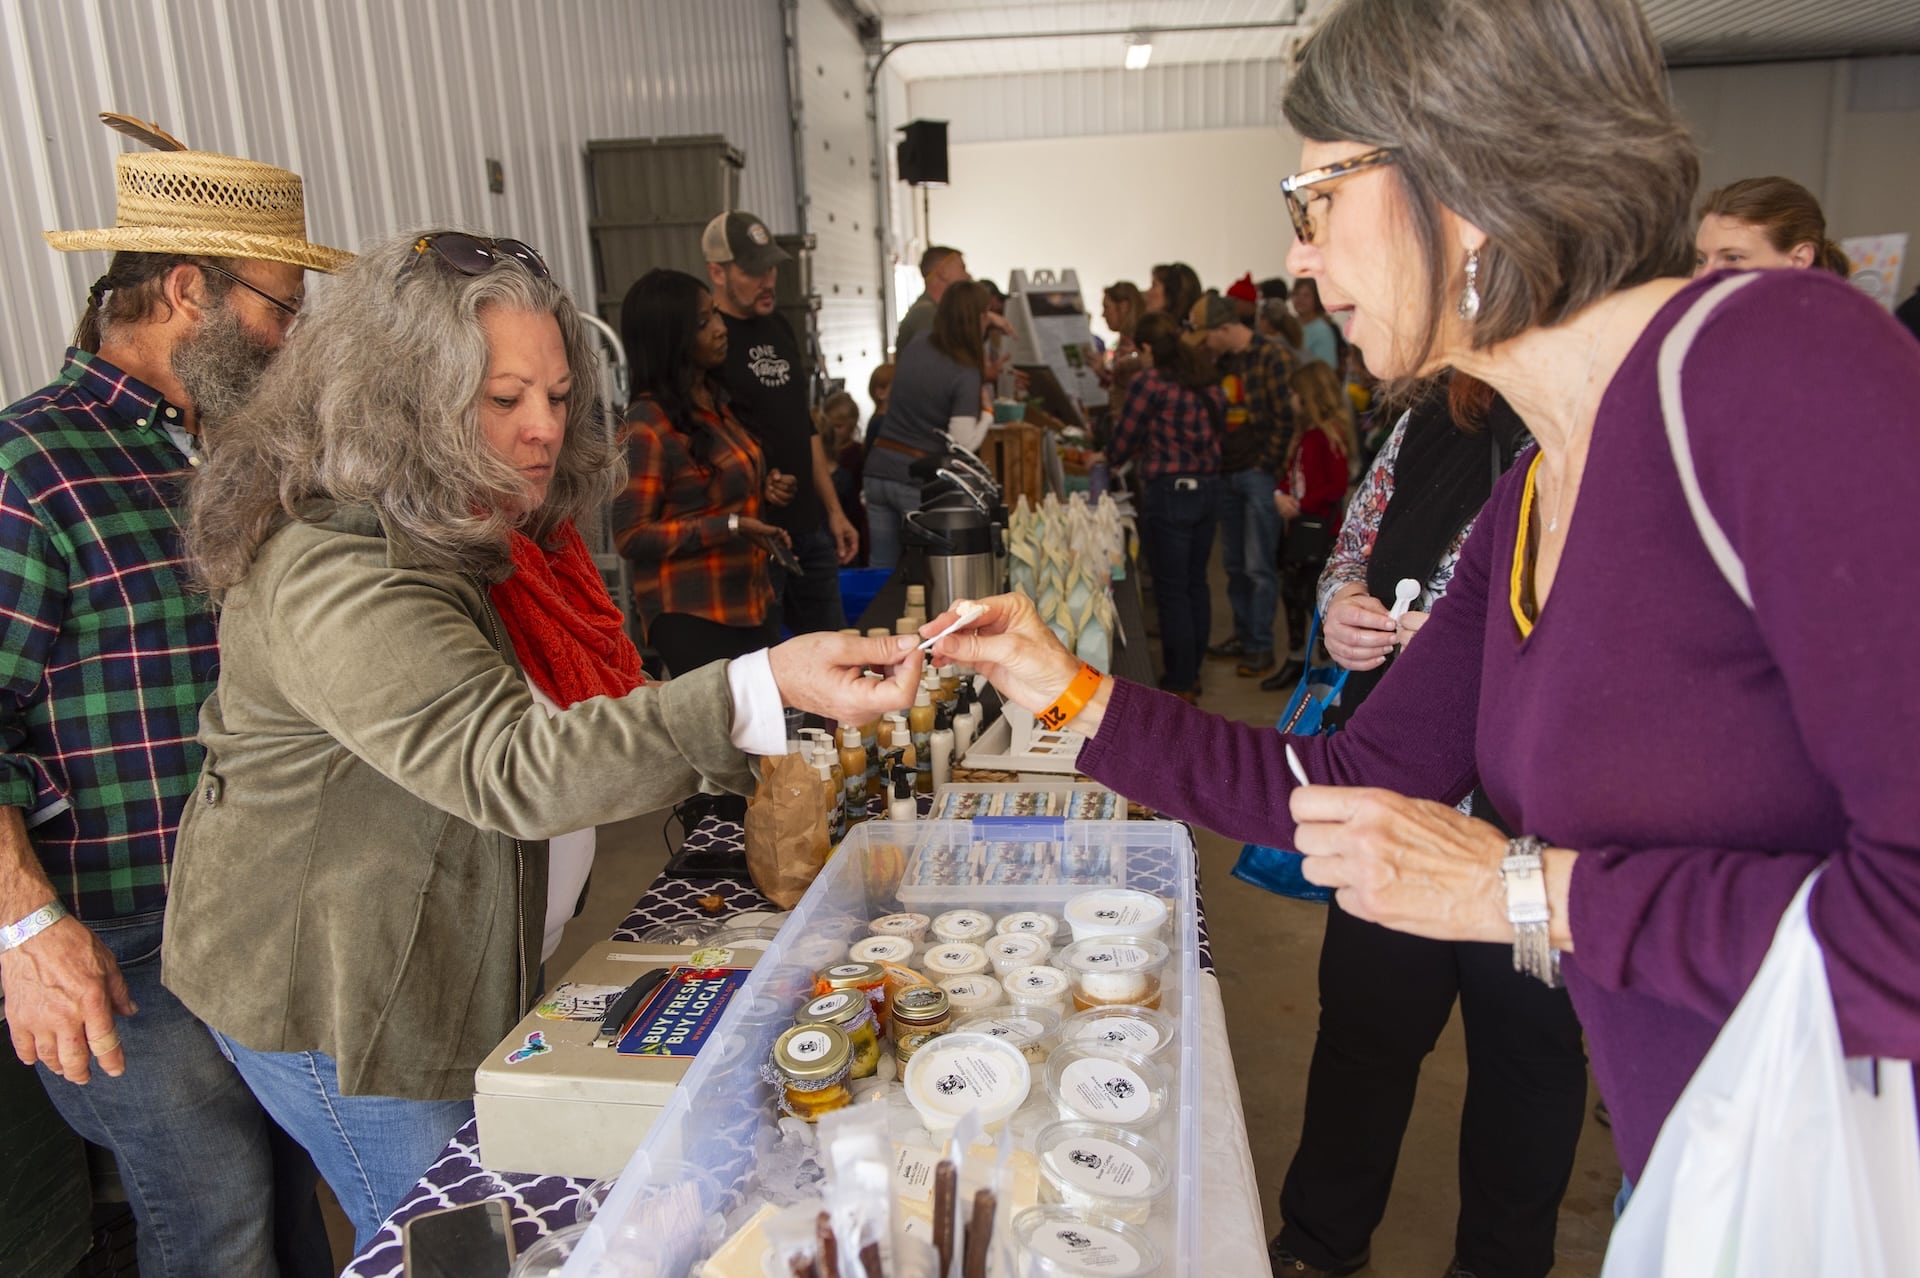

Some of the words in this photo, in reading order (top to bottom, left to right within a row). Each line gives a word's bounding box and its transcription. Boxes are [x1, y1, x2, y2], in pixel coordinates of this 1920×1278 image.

[749, 344, 778, 360] ONE
[641, 1017, 674, 1043] BUY
[663, 979, 704, 1015] FRESH
[665, 1018, 696, 1044] BUY
[685, 977, 727, 1016] LOCAL
